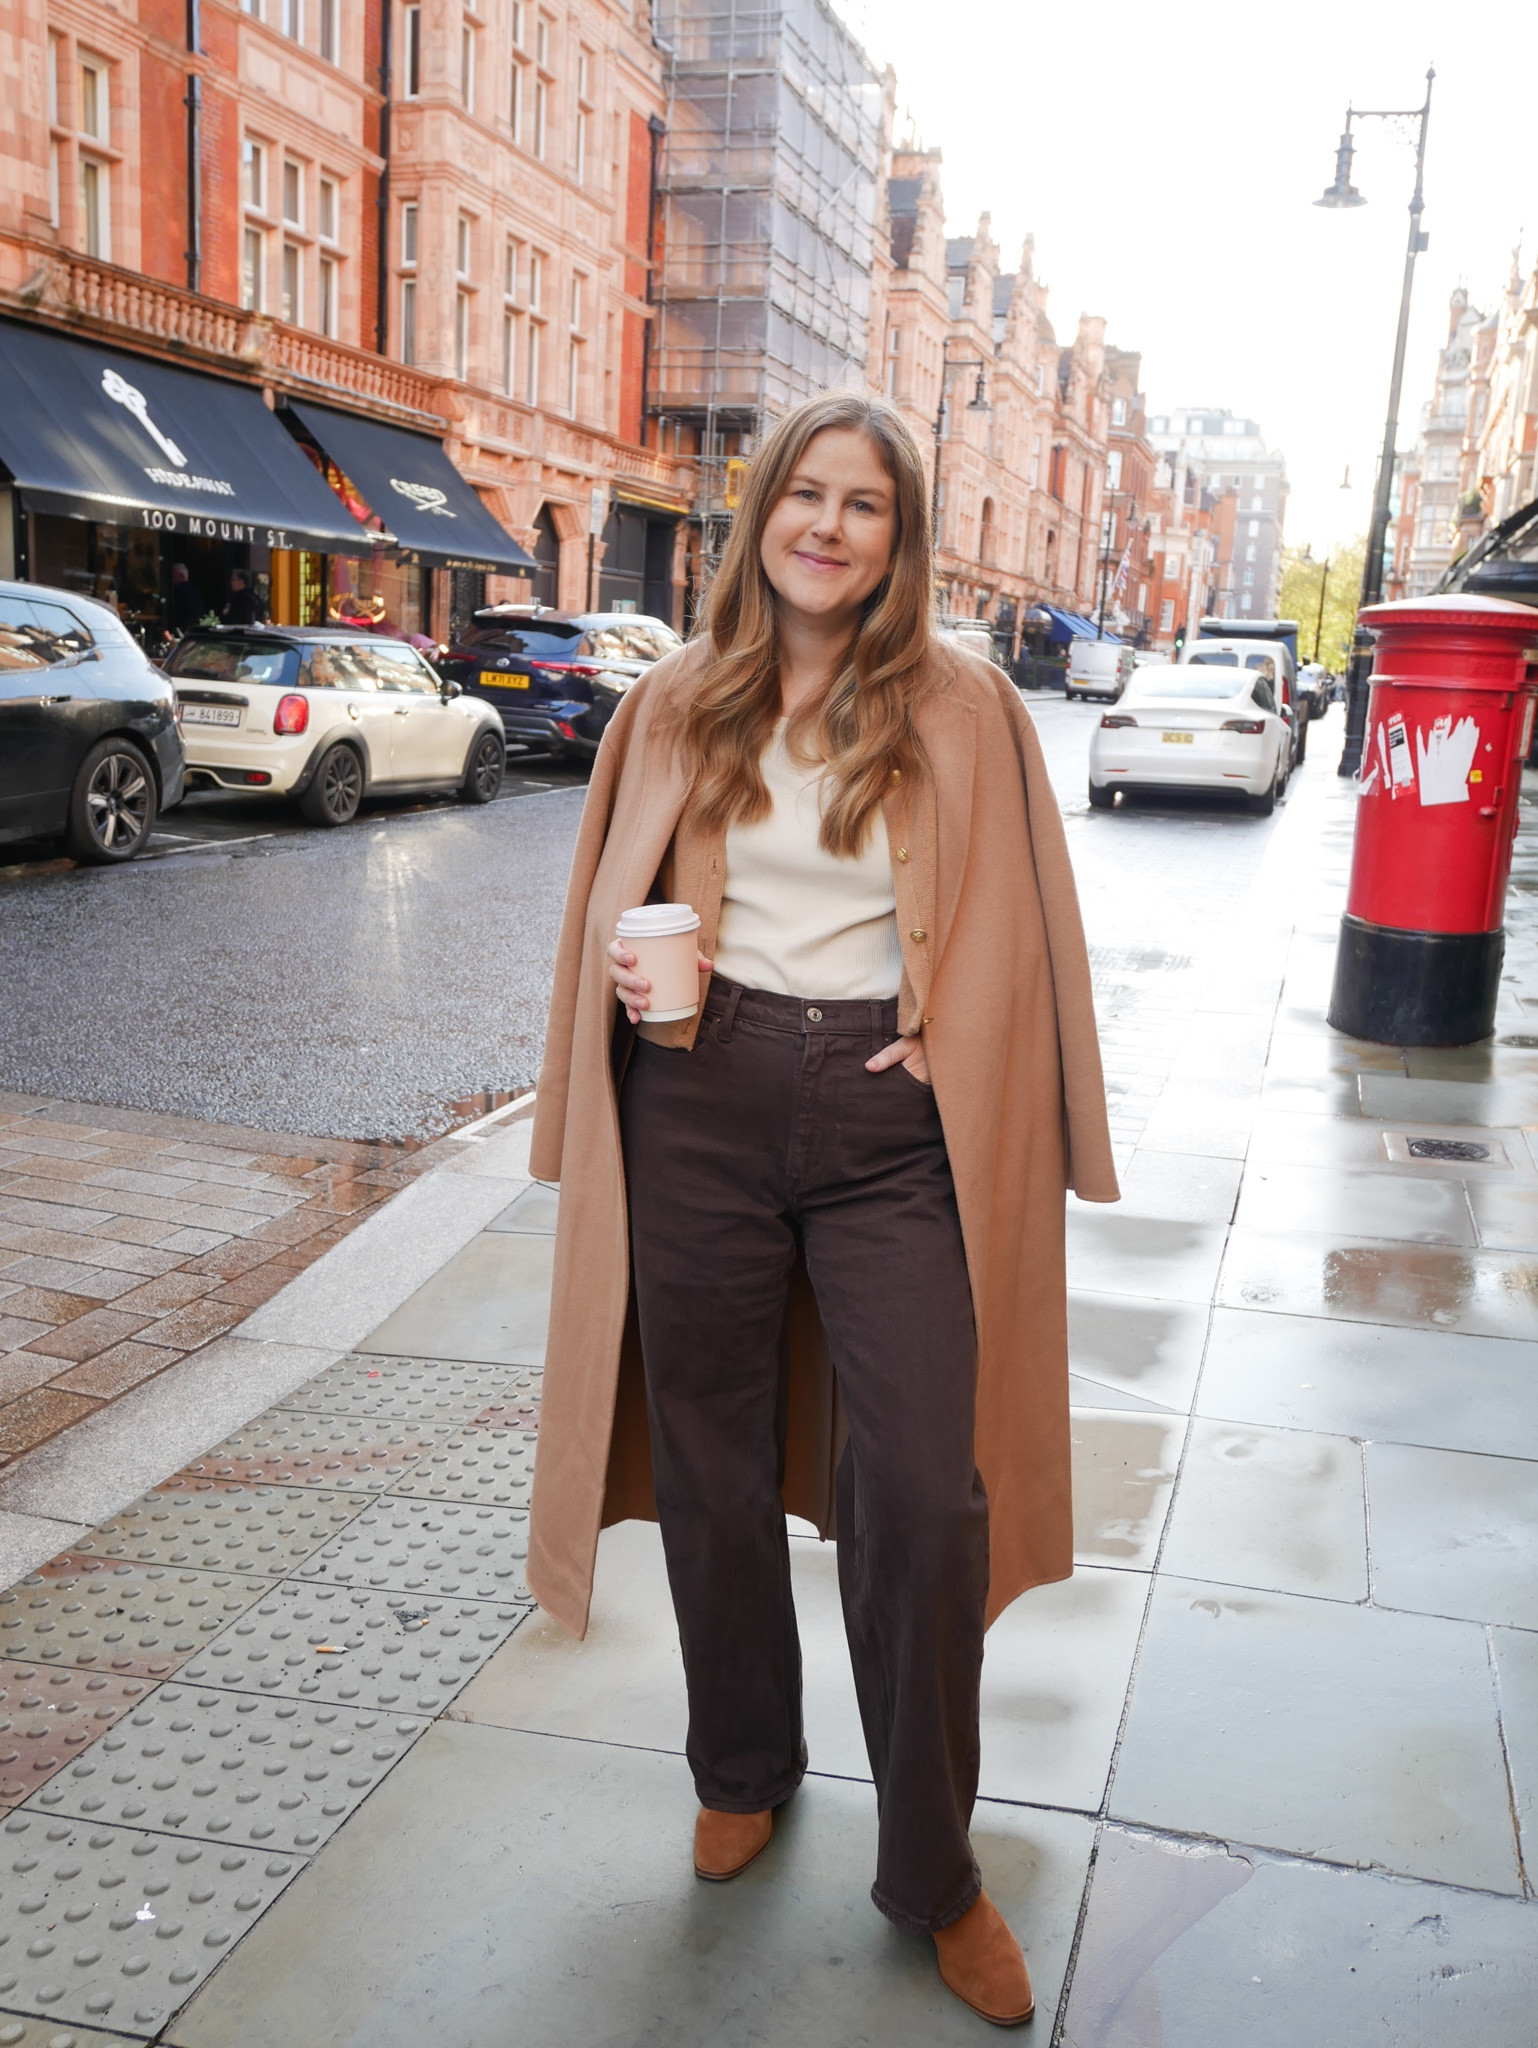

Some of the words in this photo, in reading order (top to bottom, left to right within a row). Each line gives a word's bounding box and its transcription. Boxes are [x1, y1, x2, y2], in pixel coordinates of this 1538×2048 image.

[144, 467, 236, 496] HIDEAWAY
[142, 509, 177, 531] 100
[188, 517, 256, 542] MOUNT
[267, 529, 294, 549] ST.
[199, 708, 235, 722] 841899
